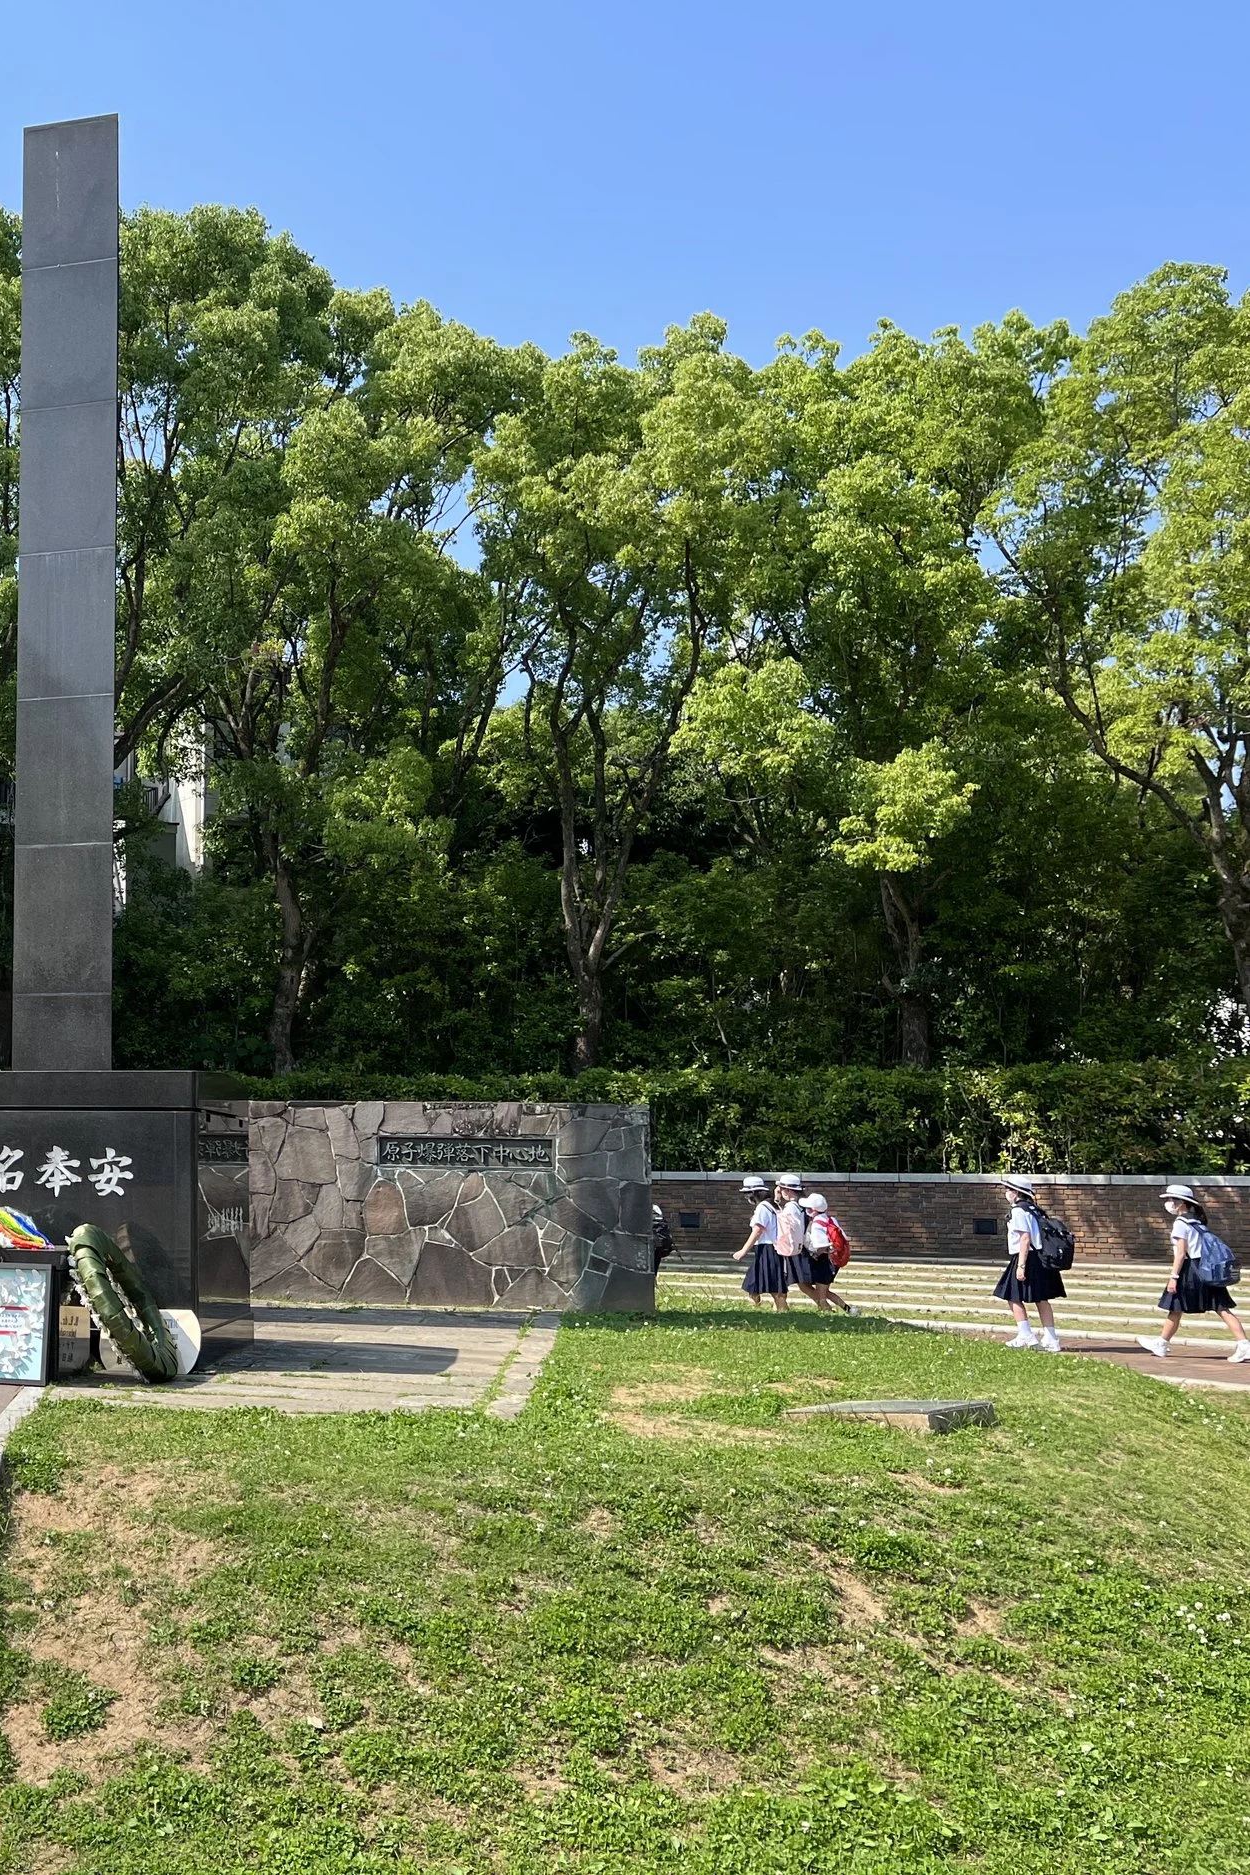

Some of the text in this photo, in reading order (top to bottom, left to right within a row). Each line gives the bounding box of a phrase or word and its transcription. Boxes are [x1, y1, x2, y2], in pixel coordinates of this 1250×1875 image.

[382, 1140, 550, 1163] 原子爆弾落下中心地
